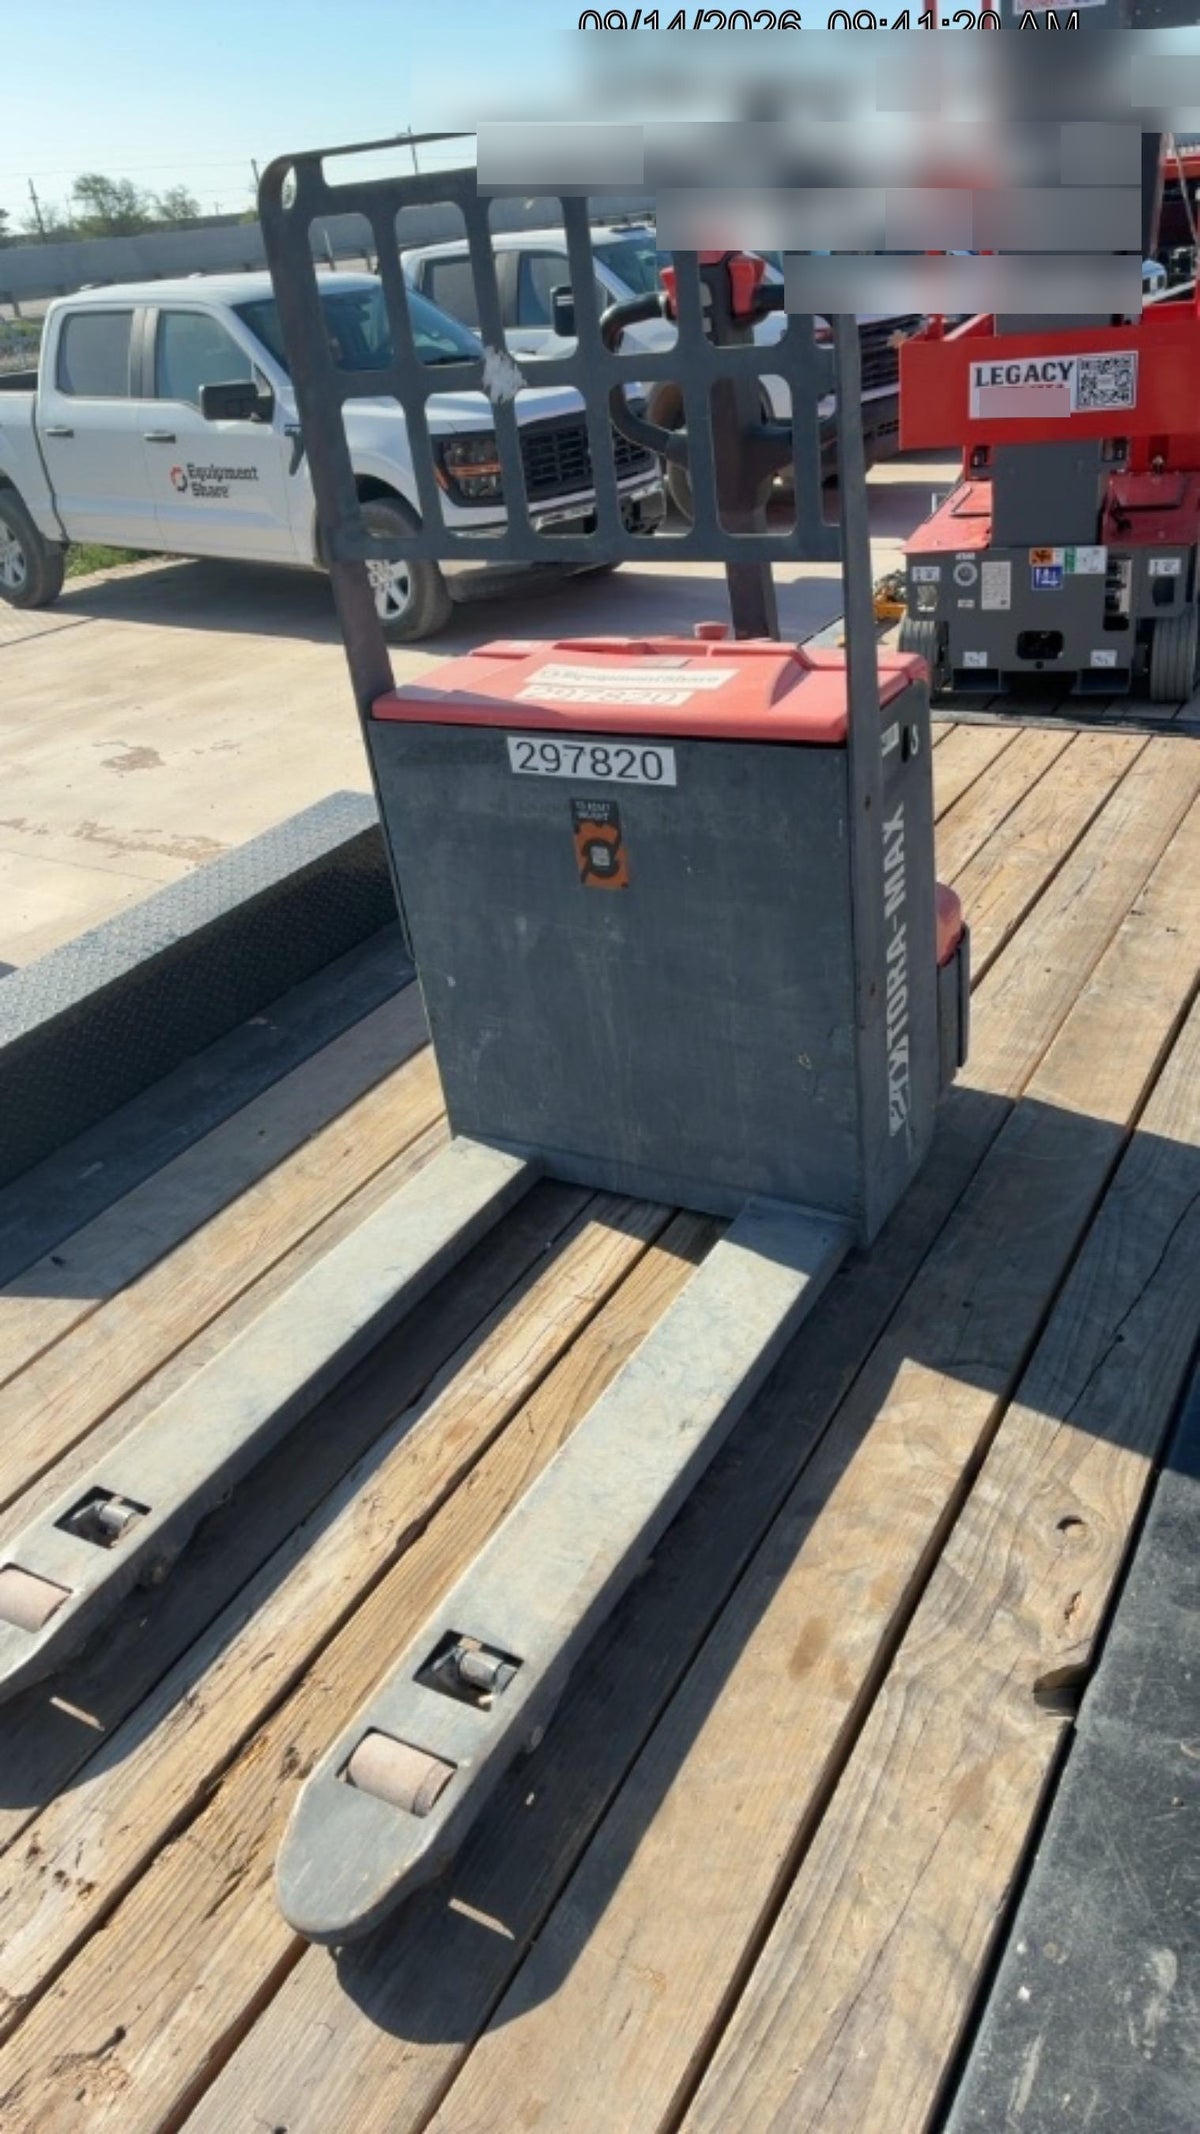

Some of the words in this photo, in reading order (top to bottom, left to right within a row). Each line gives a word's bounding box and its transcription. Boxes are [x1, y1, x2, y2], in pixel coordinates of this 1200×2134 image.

[975, 361, 1075, 387] LEGACY
[187, 463, 259, 483] Equipment
[191, 482, 229, 498] Share
[516, 741, 663, 781] 297820
